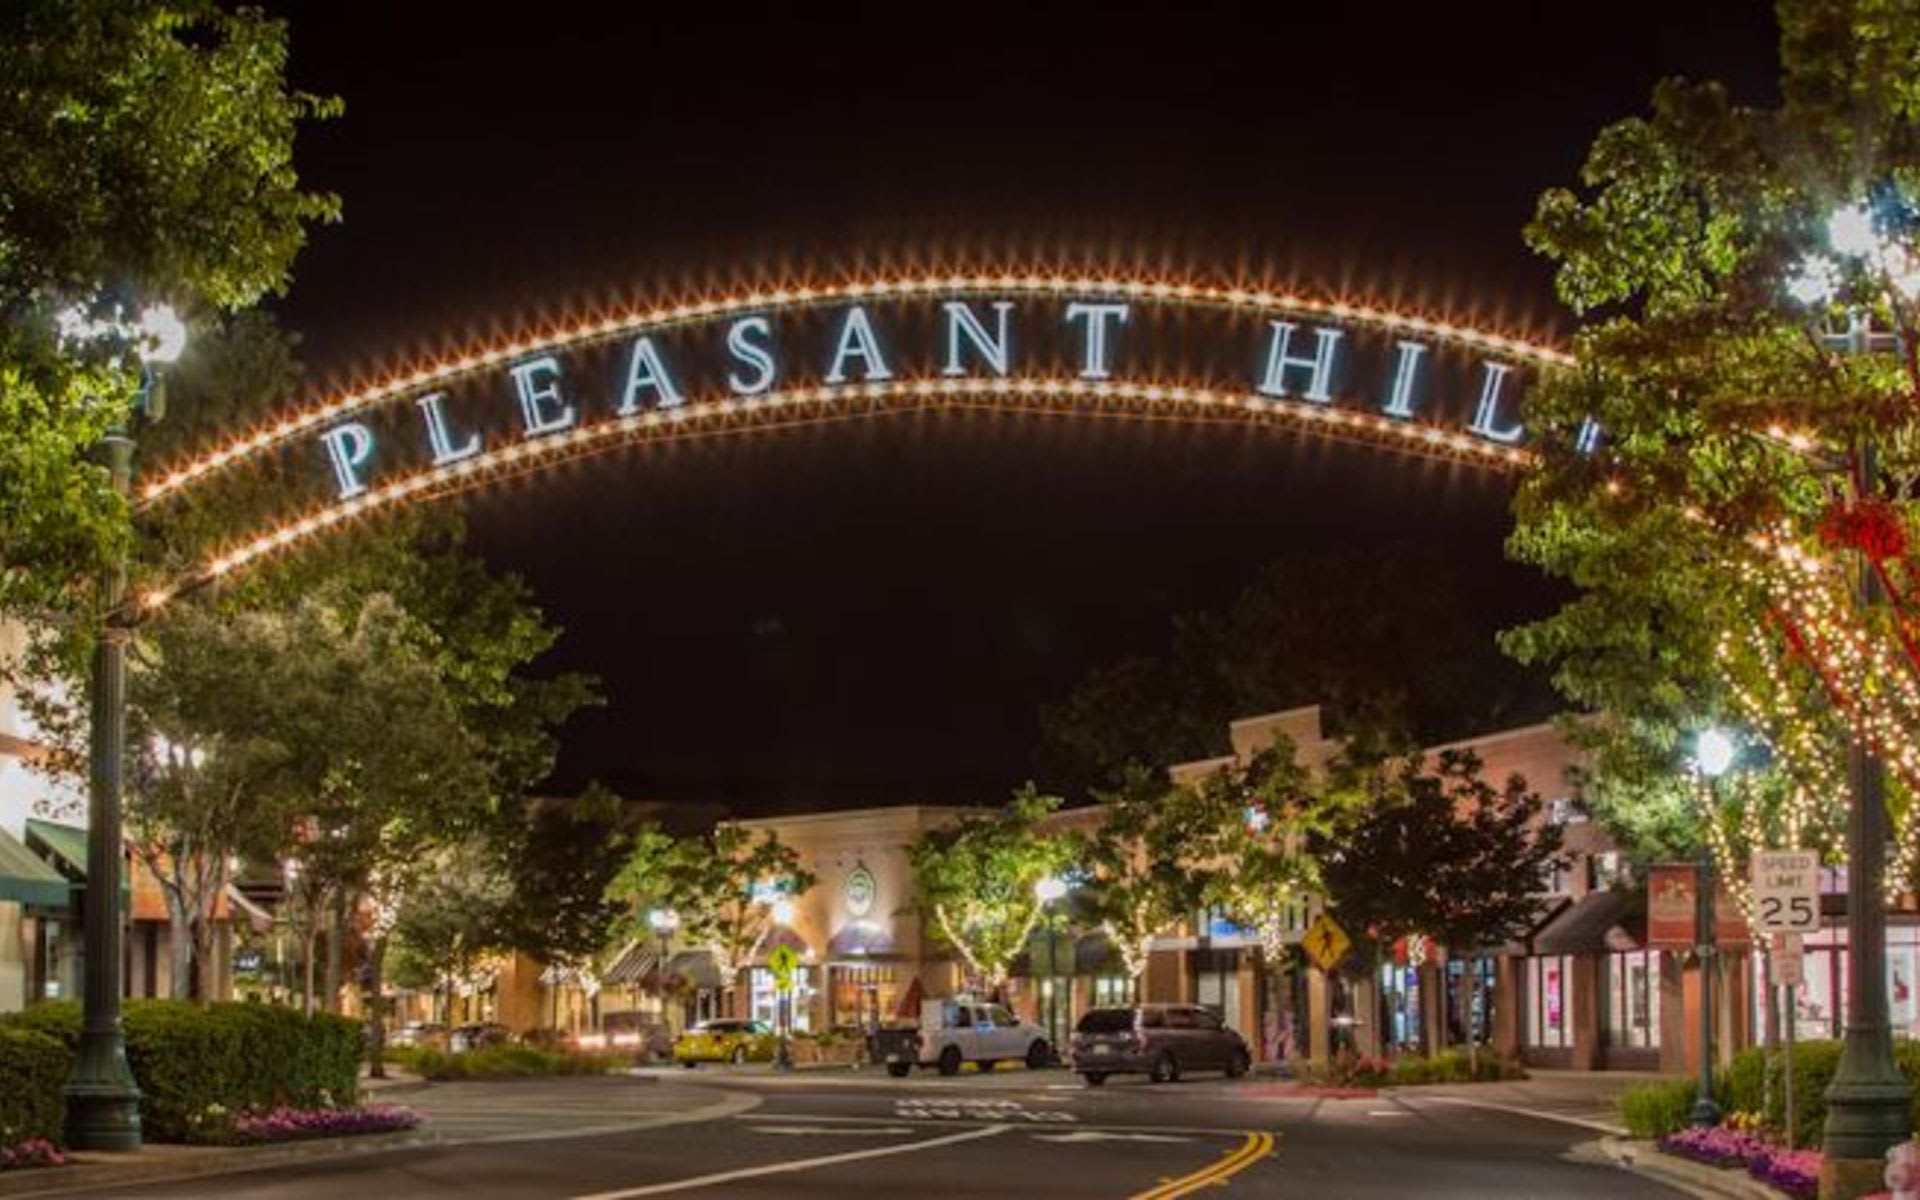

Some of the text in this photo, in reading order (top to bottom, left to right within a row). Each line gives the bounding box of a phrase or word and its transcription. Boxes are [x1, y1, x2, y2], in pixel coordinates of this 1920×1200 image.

[320, 301, 1130, 498] PLEASANT
[1761, 856, 1810, 870] SPEED
[1766, 875, 1803, 888] LIMIT
[1760, 896, 1813, 926] 25
